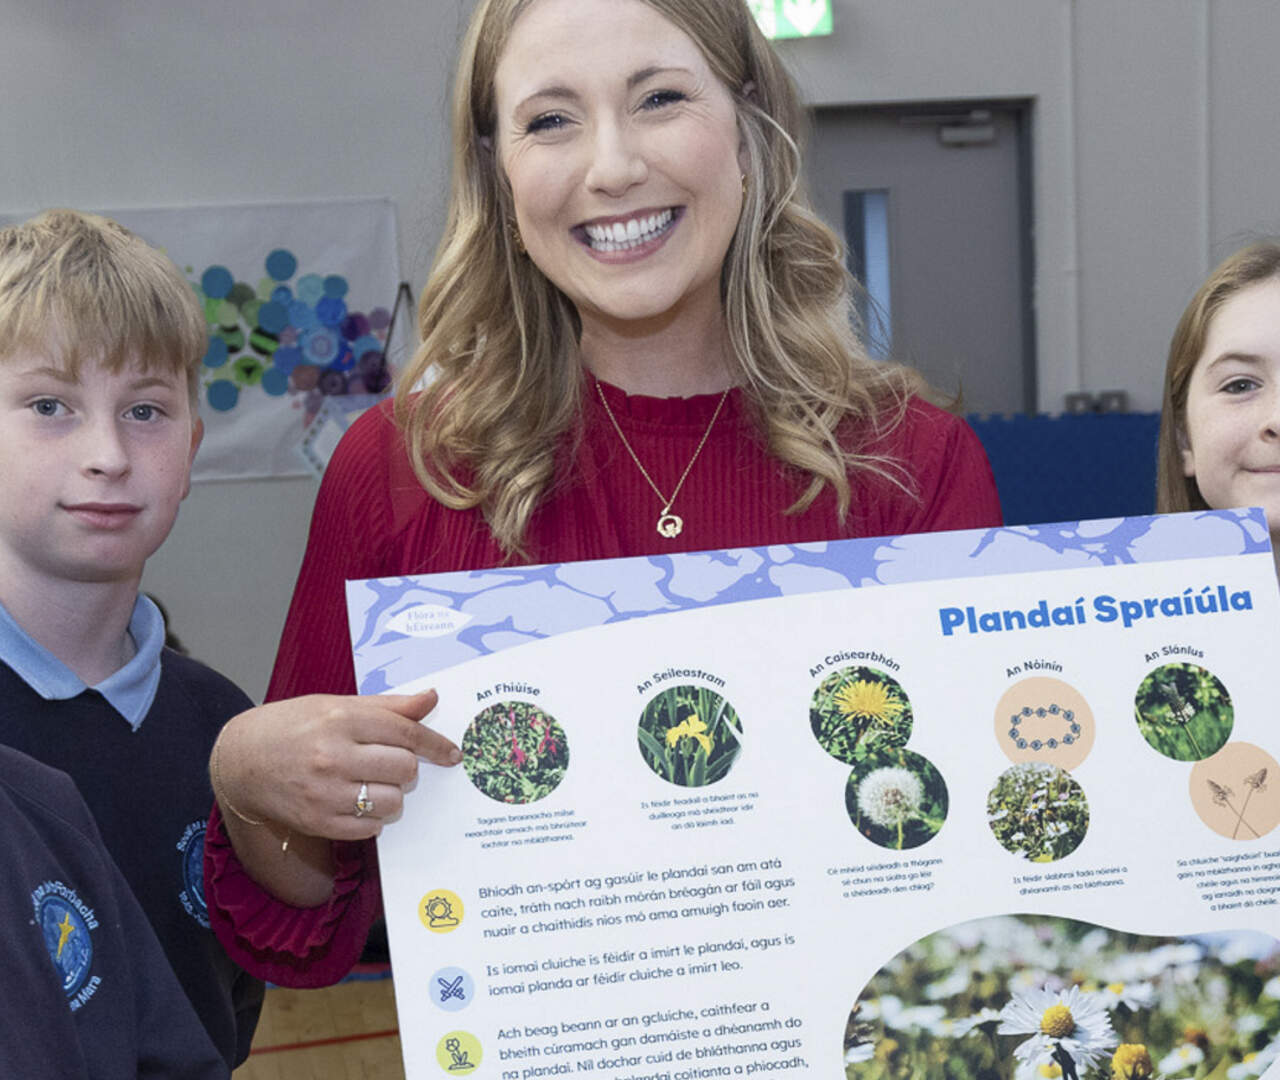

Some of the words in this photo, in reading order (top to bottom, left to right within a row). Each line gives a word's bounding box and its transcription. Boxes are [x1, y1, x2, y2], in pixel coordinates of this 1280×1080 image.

[938, 596, 1086, 636] Plandaí
[1092, 584, 1253, 628] Spraíúla
[809, 663, 824, 678] An
[824, 649, 900, 671] Caisearbhán
[1006, 666, 1021, 677] An
[1145, 651, 1159, 662] An
[1162, 644, 1204, 658] Slánlus
[477, 690, 492, 701] An
[637, 680, 652, 694] An
[653, 668, 726, 688] Seileastram
[525, 878, 580, 894] an-spórt
[583, 878, 602, 890] ag
[604, 871, 644, 889] gasúir
[646, 870, 658, 881] le
[710, 864, 734, 875] san
[736, 862, 757, 872] am
[759, 857, 782, 870] atá
[480, 905, 517, 918] caite,
[519, 901, 551, 914] tráth
[553, 897, 586, 910] nach
[588, 893, 622, 907] raibh
[624, 889, 666, 903] mórán
[668, 883, 722, 899] bréagán
[724, 883, 738, 893] ar
[741, 878, 762, 891] fáil
[763, 877, 795, 891] agus
[482, 924, 516, 938] nuair
[519, 924, 529, 934] a
[624, 911, 646, 923] mó
[648, 909, 678, 921] ama
[680, 902, 729, 918] amuigh
[731, 899, 764, 912] faoin
[766, 898, 790, 908] aer.
[486, 965, 499, 976] Is
[541, 956, 586, 971] cluiche
[588, 954, 600, 965] is
[602, 950, 635, 964] féidir
[638, 950, 648, 960] a
[650, 946, 680, 958] imirt
[682, 944, 695, 955] le
[750, 936, 782, 950] agus
[784, 933, 795, 945] is
[527, 977, 573, 994] planda
[575, 976, 589, 987] ar
[592, 971, 626, 985] féidir
[628, 966, 673, 981] cluiche
[675, 966, 686, 976] a
[687, 961, 717, 975] imirt
[720, 960, 743, 971] leo.
[497, 1027, 522, 1040] Ach
[524, 1025, 558, 1037] beag
[560, 1019, 602, 1033] beann
[604, 1018, 618, 1028] ar
[620, 1016, 639, 1026] an
[640, 1009, 698, 1027] gcluiche,
[699, 1002, 757, 1018] caithfear
[760, 1001, 770, 1011] a
[498, 1045, 541, 1060] bheith
[543, 1038, 608, 1055] cúramach
[610, 1036, 637, 1051] gan
[638, 1029, 700, 1045] damáiste
[701, 1028, 712, 1038] a
[713, 1018, 782, 1036] dhéanamh
[784, 1016, 802, 1028] do
[501, 1070, 519, 1080] na
[596, 1055, 642, 1070] dochar
[644, 1050, 673, 1064] cuid
[675, 1049, 692, 1061] de
[694, 1042, 768, 1058] bhláthanna
[769, 1038, 802, 1052] agus
[673, 1066, 731, 1080] coitianta
[733, 1064, 743, 1074] a
[745, 1056, 809, 1075] phiocadh,
